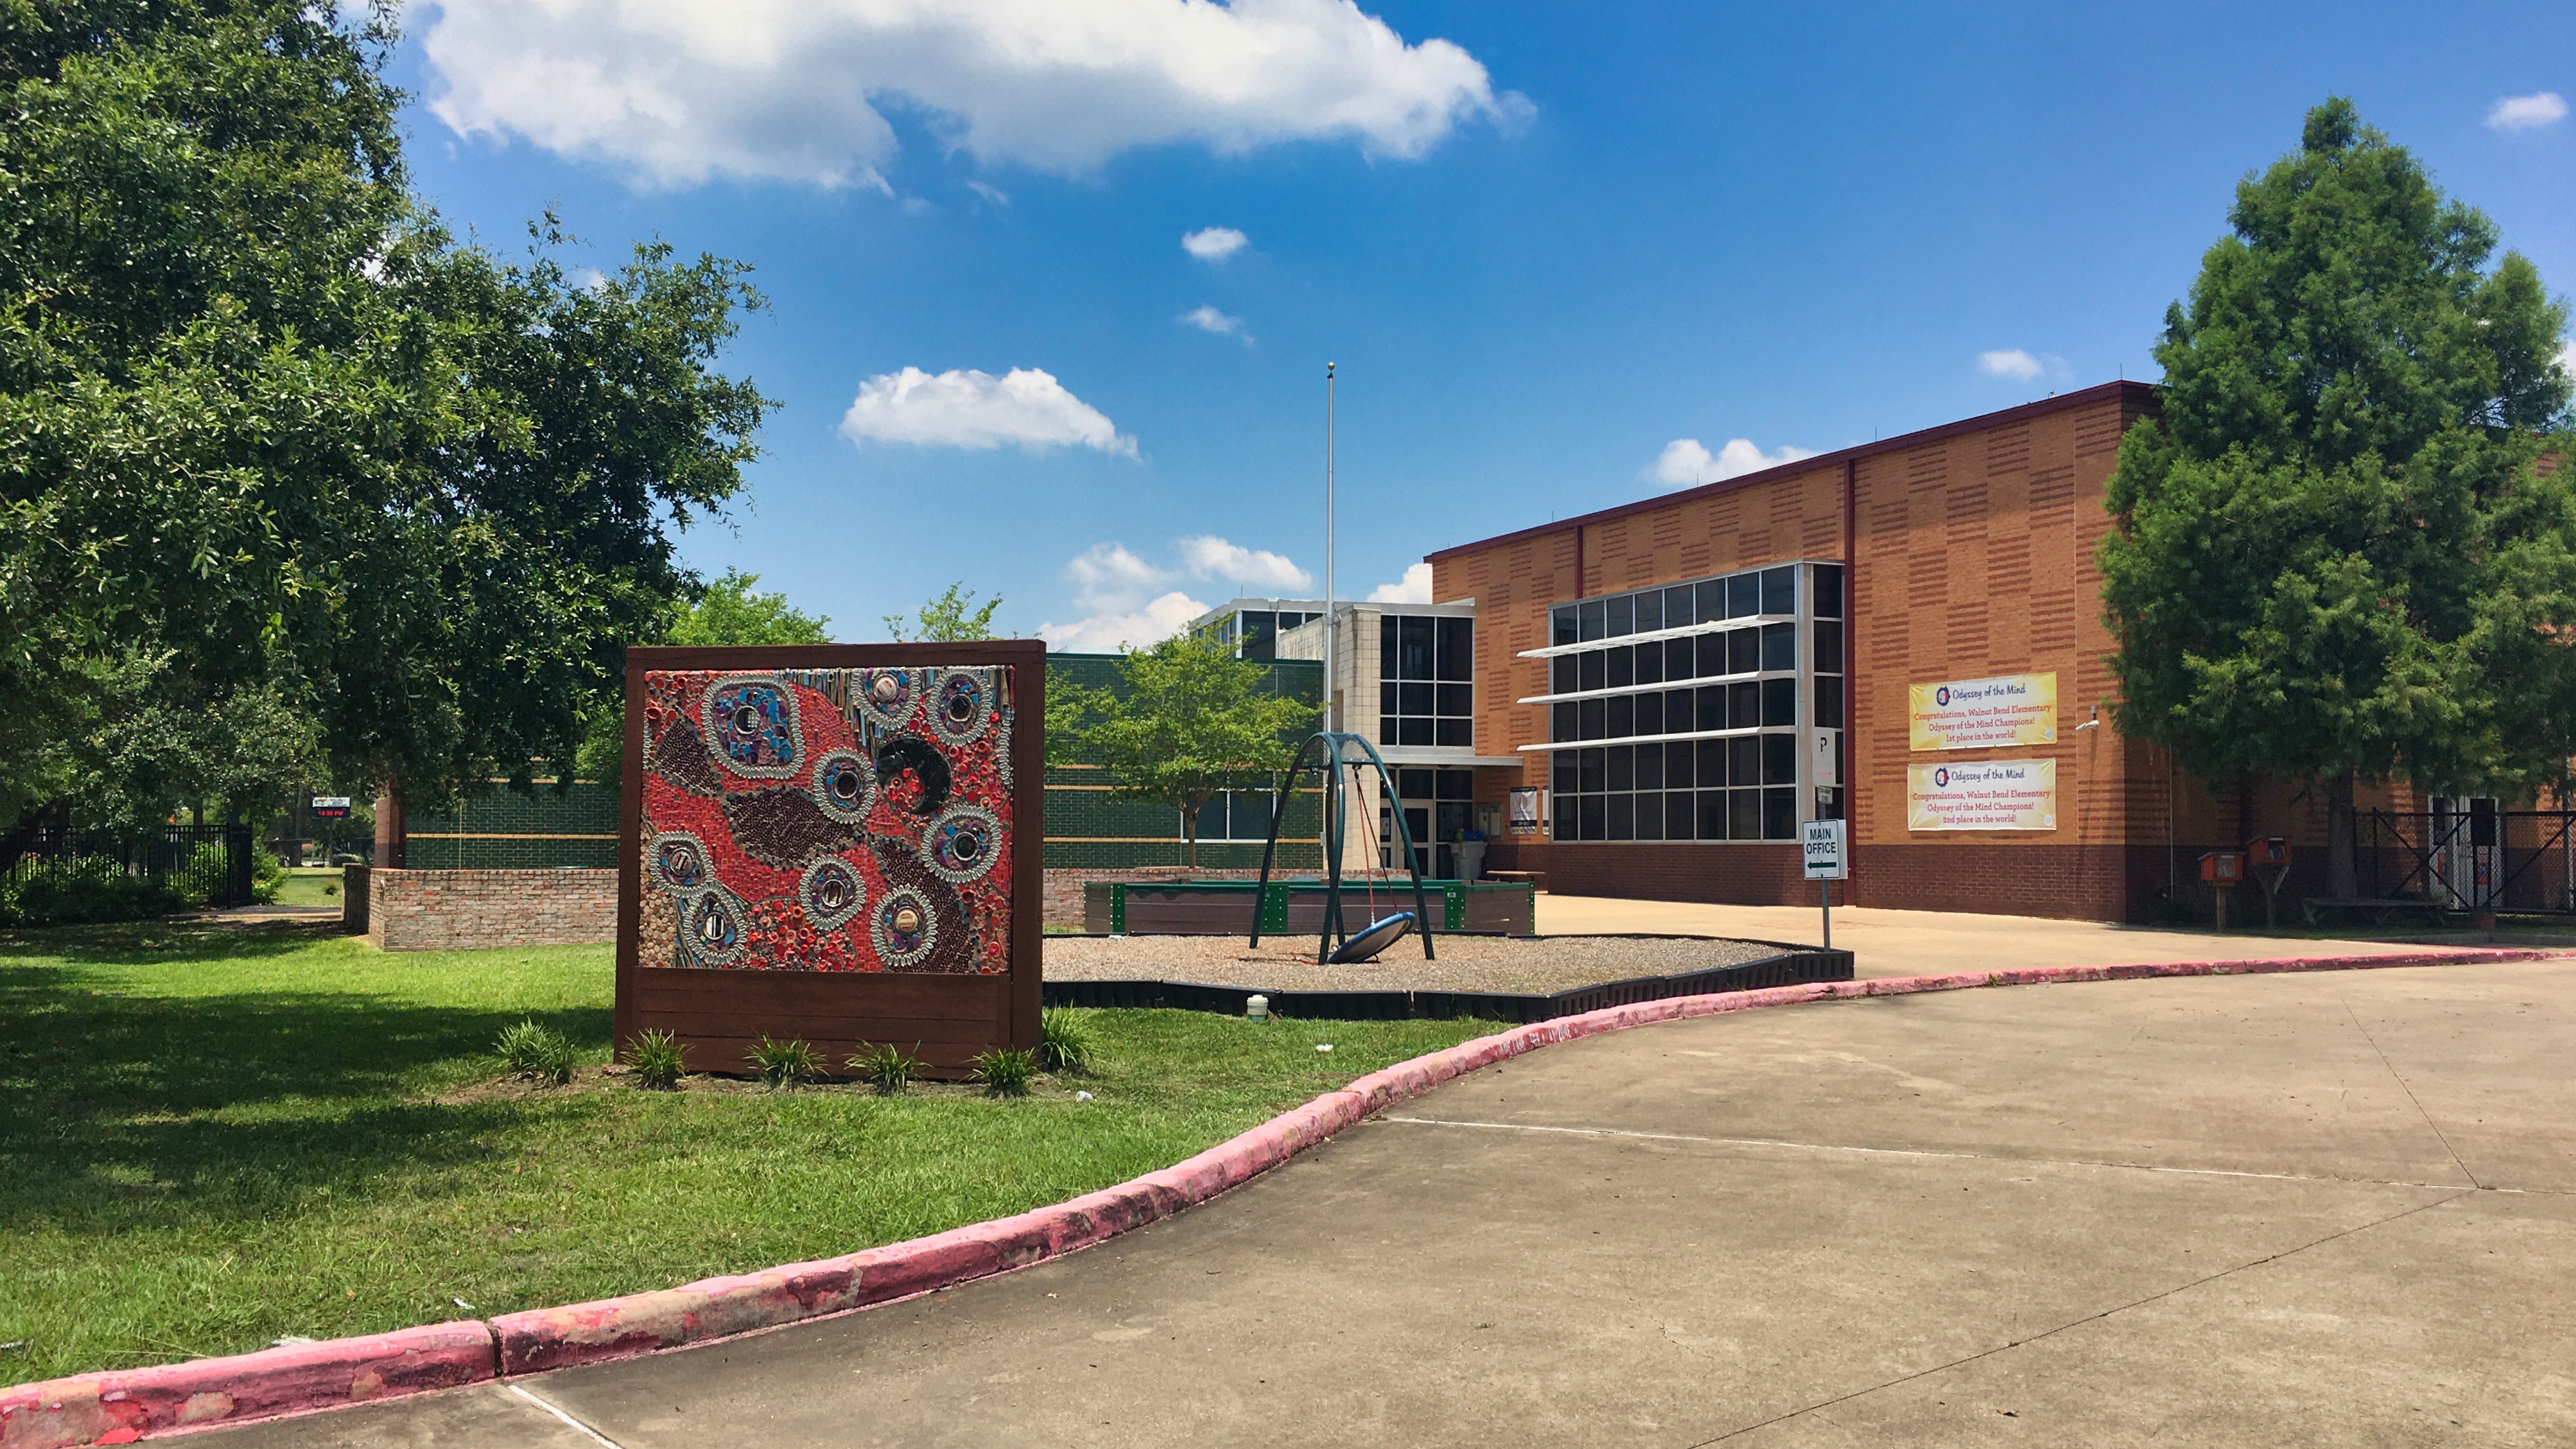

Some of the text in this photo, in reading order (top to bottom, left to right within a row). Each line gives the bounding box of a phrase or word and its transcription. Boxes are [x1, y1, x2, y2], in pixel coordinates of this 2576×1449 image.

[1953, 683, 2026, 701] Odyssey of the Mind
[1914, 705, 2051, 721] Congratulations, Walnut Bend Elementary
[1929, 717, 2035, 732] Odyssey of the Mind Champions!
[1956, 733, 1973, 743] place
[1983, 731, 1993, 740] the
[1995, 729, 2016, 739] world!
[1951, 768, 2025, 783] Odyssey of the Mind
[1913, 789, 2050, 802] Congratulations, Walnut Bend Elementary
[1927, 802, 2034, 813] Odyssey of the Mind Champions!
[1943, 815, 1955, 823] 2nd
[1956, 815, 1974, 824] place
[1983, 814, 1994, 822] the
[1995, 814, 2017, 822] world!
[1809, 828, 1831, 840] MAIN
[1806, 842, 1836, 855] OFFICE
